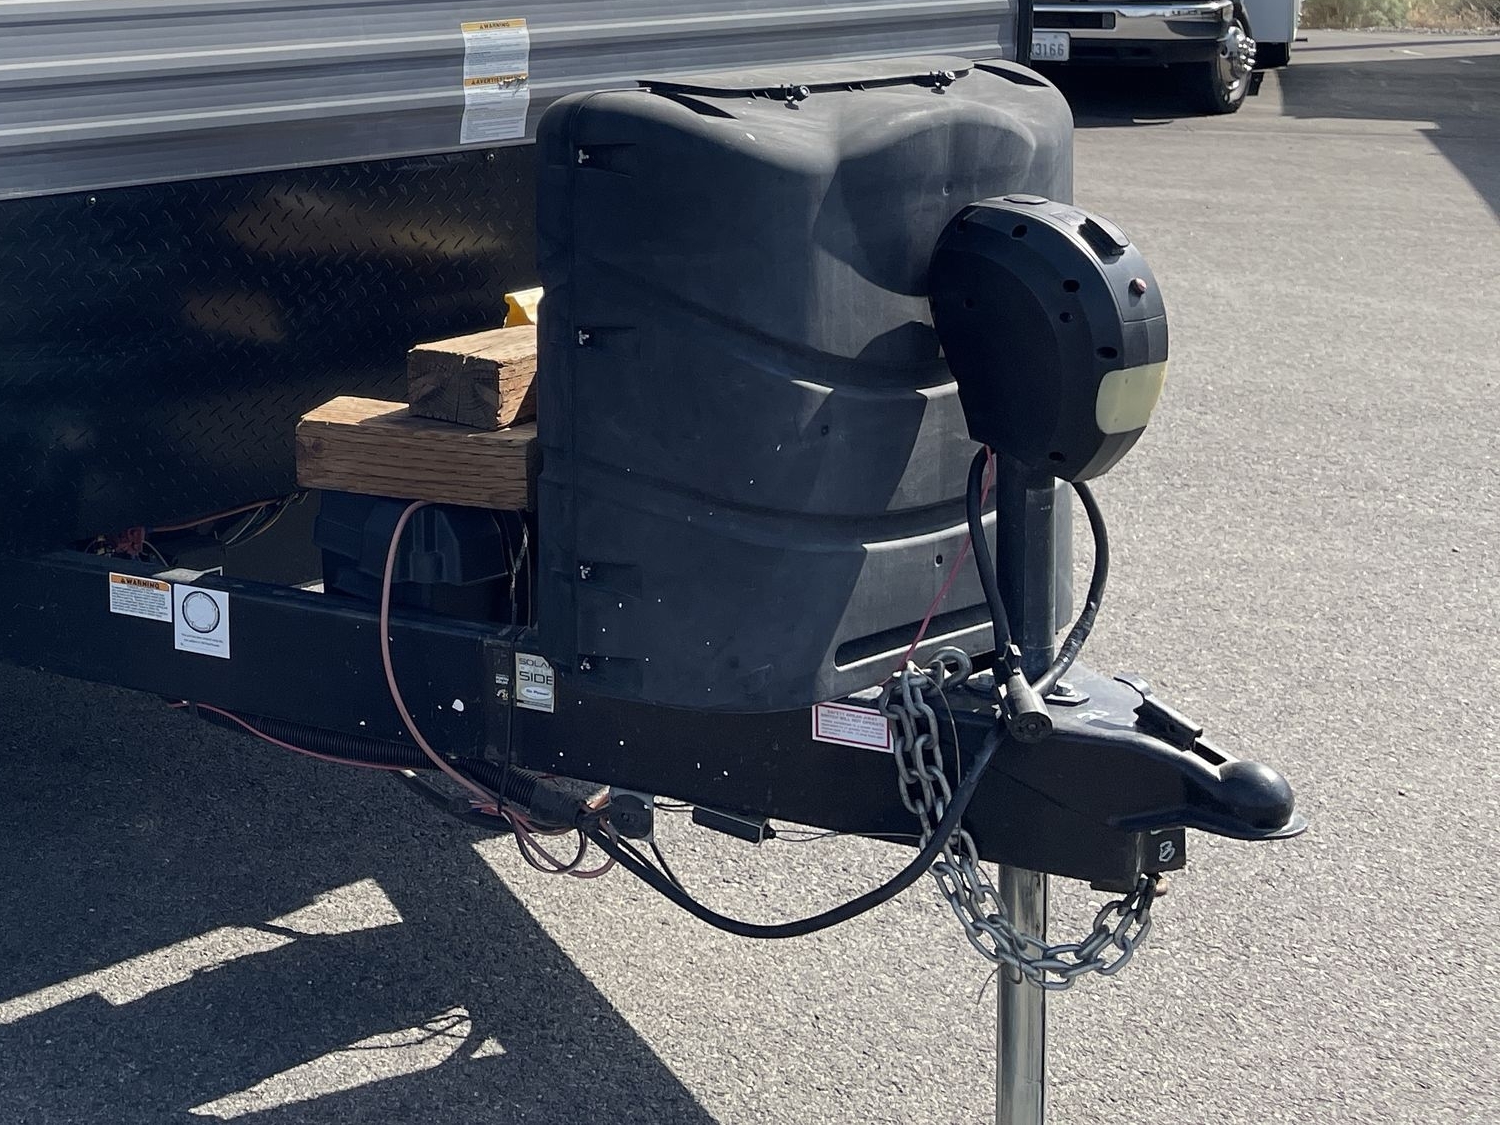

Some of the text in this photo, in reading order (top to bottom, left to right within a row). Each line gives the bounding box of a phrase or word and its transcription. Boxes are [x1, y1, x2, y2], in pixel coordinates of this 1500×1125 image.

[126, 578, 160, 590] WARNING
[518, 657, 551, 669] SOLA
[519, 671, 553, 686] SIDE
